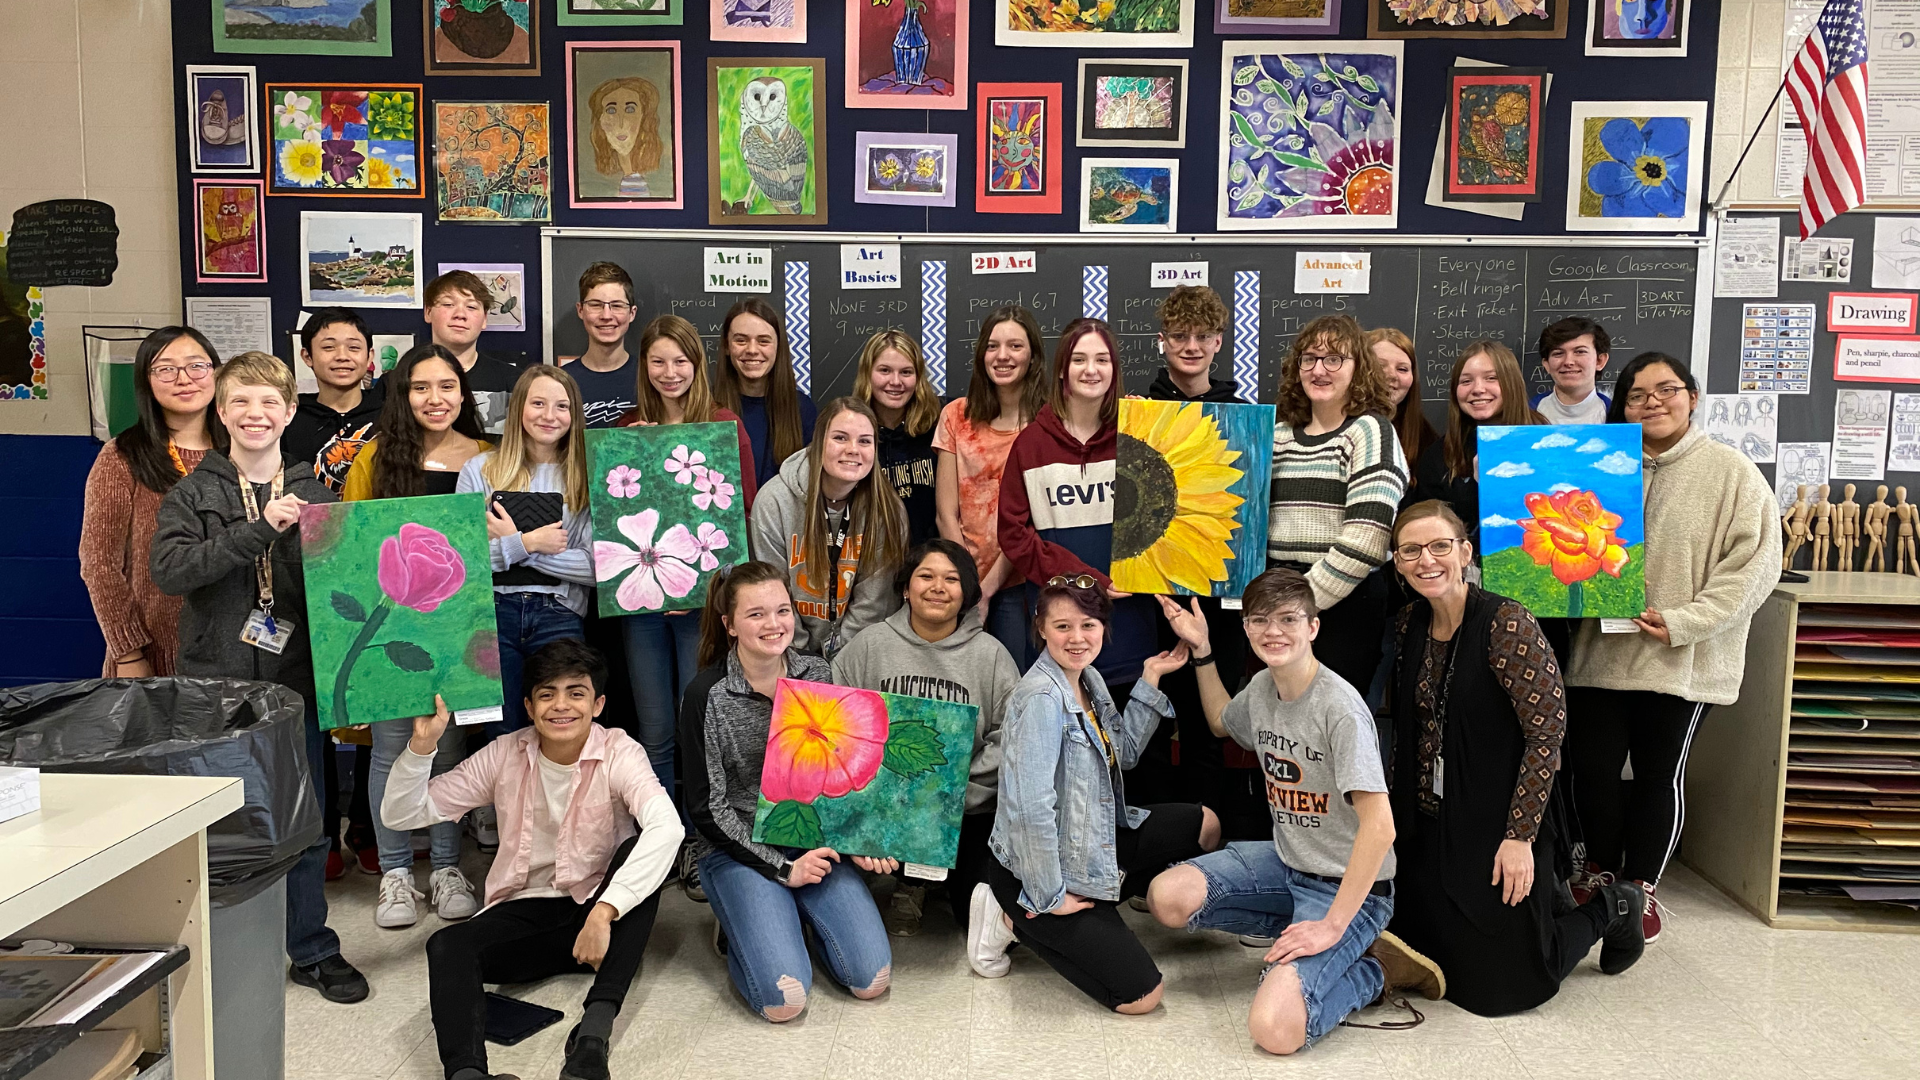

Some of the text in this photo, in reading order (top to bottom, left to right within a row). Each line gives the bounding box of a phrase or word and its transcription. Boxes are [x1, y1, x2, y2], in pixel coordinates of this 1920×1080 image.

[55, 204, 101, 215] NOTICE
[56, 226, 85, 234] MONA
[713, 252, 763, 264] Art in
[857, 248, 885, 260] Art
[974, 256, 1034, 270] 2D Art
[1302, 259, 1363, 271] Advanced
[1439, 256, 1516, 282] Everyone
[1549, 255, 1609, 280] Google
[709, 275, 768, 287] Motion
[845, 270, 898, 283] Basics
[1157, 269, 1203, 280] 3D Art
[1322, 278, 1343, 288] Art
[1440, 280, 1522, 302] Bell ringer
[1538, 287, 1569, 307] Adv
[1660, 291, 1684, 302] ART
[671, 295, 716, 315] period
[829, 296, 908, 315] NONE 3RD
[969, 291, 1022, 313] period
[1124, 297, 1162, 314] perio
[1272, 295, 1350, 317] period 5
[1437, 302, 1518, 319] Exit Ticket
[1840, 305, 1907, 323] Drawing
[836, 319, 906, 337] 9 weeks
[1117, 319, 1152, 332] This
[1436, 323, 1505, 339] Sketches
[1846, 348, 1862, 357] Pen,
[1864, 349, 1890, 358] sharpie,
[1860, 359, 1881, 367] pencil
[1426, 375, 1452, 387] Wor
[911, 458, 935, 488] IRISH
[1305, 746, 1324, 764] OF
